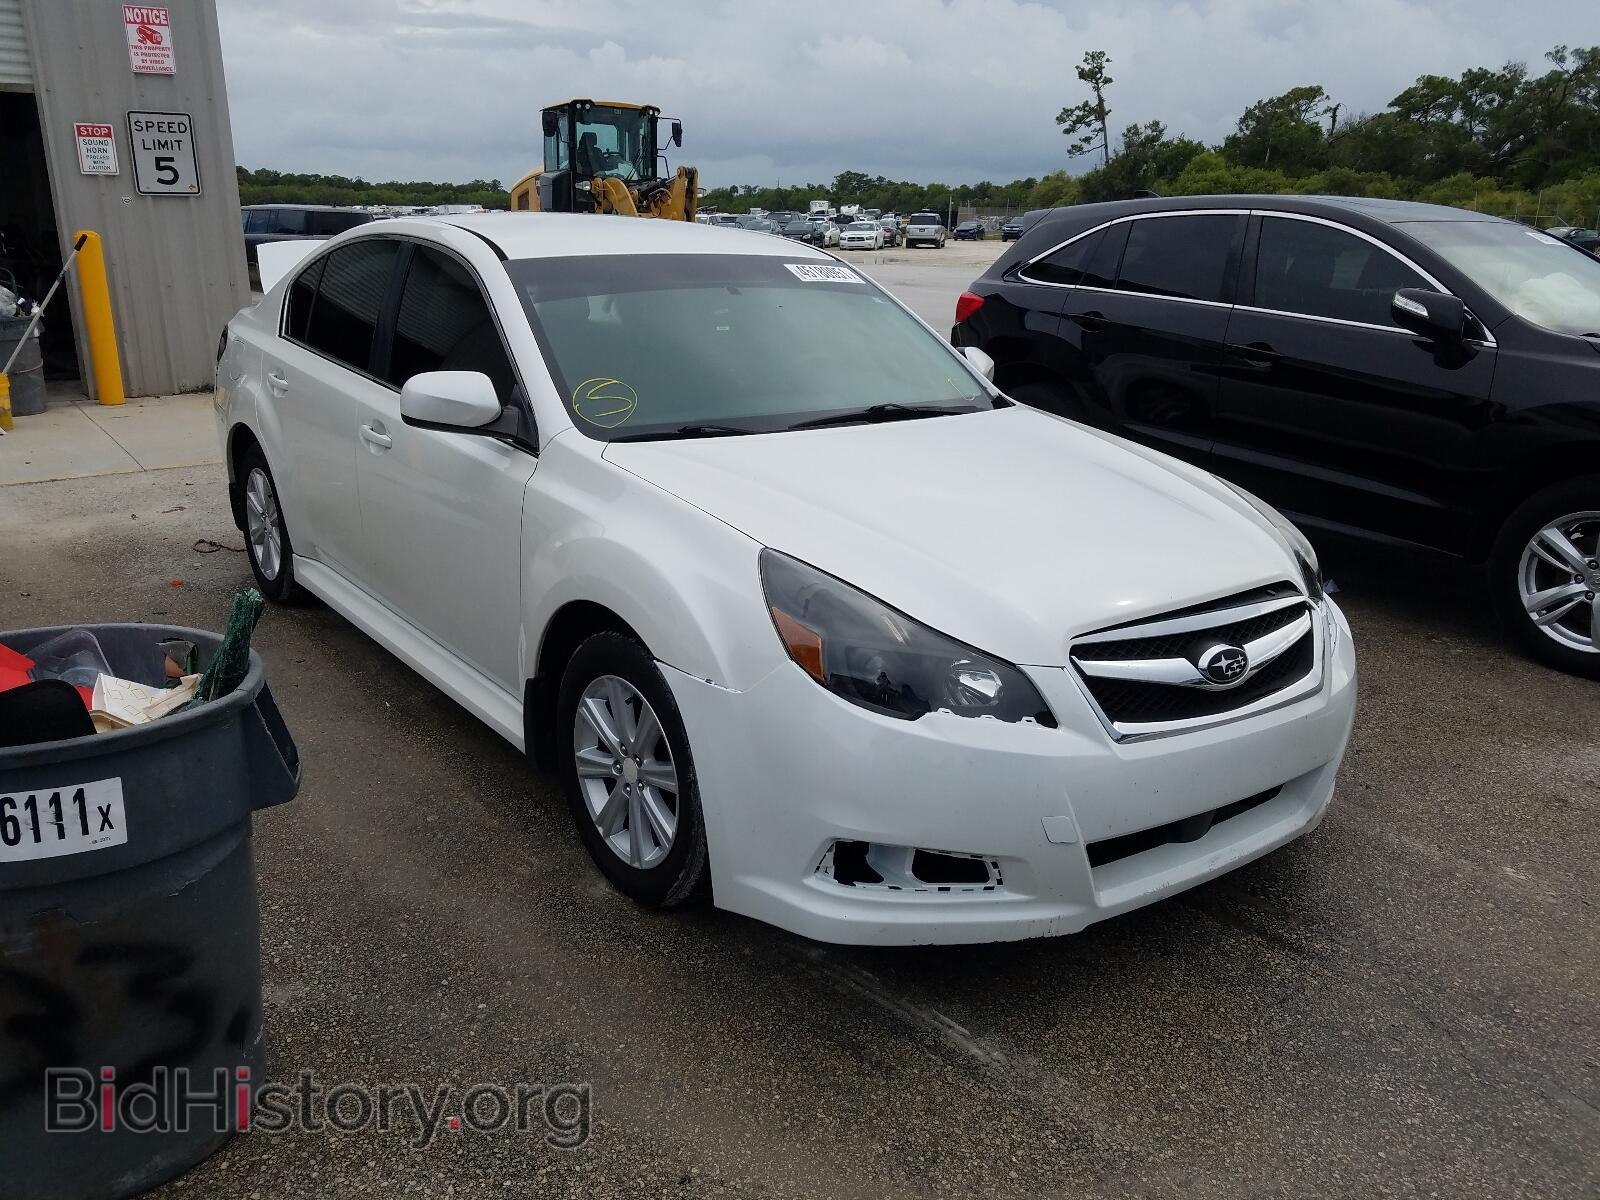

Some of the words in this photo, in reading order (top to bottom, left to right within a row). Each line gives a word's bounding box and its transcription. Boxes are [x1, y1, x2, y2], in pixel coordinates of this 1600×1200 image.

[124, 7, 168, 25] NOTICE
[80, 126, 109, 136] STOP
[134, 120, 187, 134] SPEED
[82, 138, 110, 147] SOUND
[142, 138, 183, 151] LIMIT
[154, 156, 180, 186] 5
